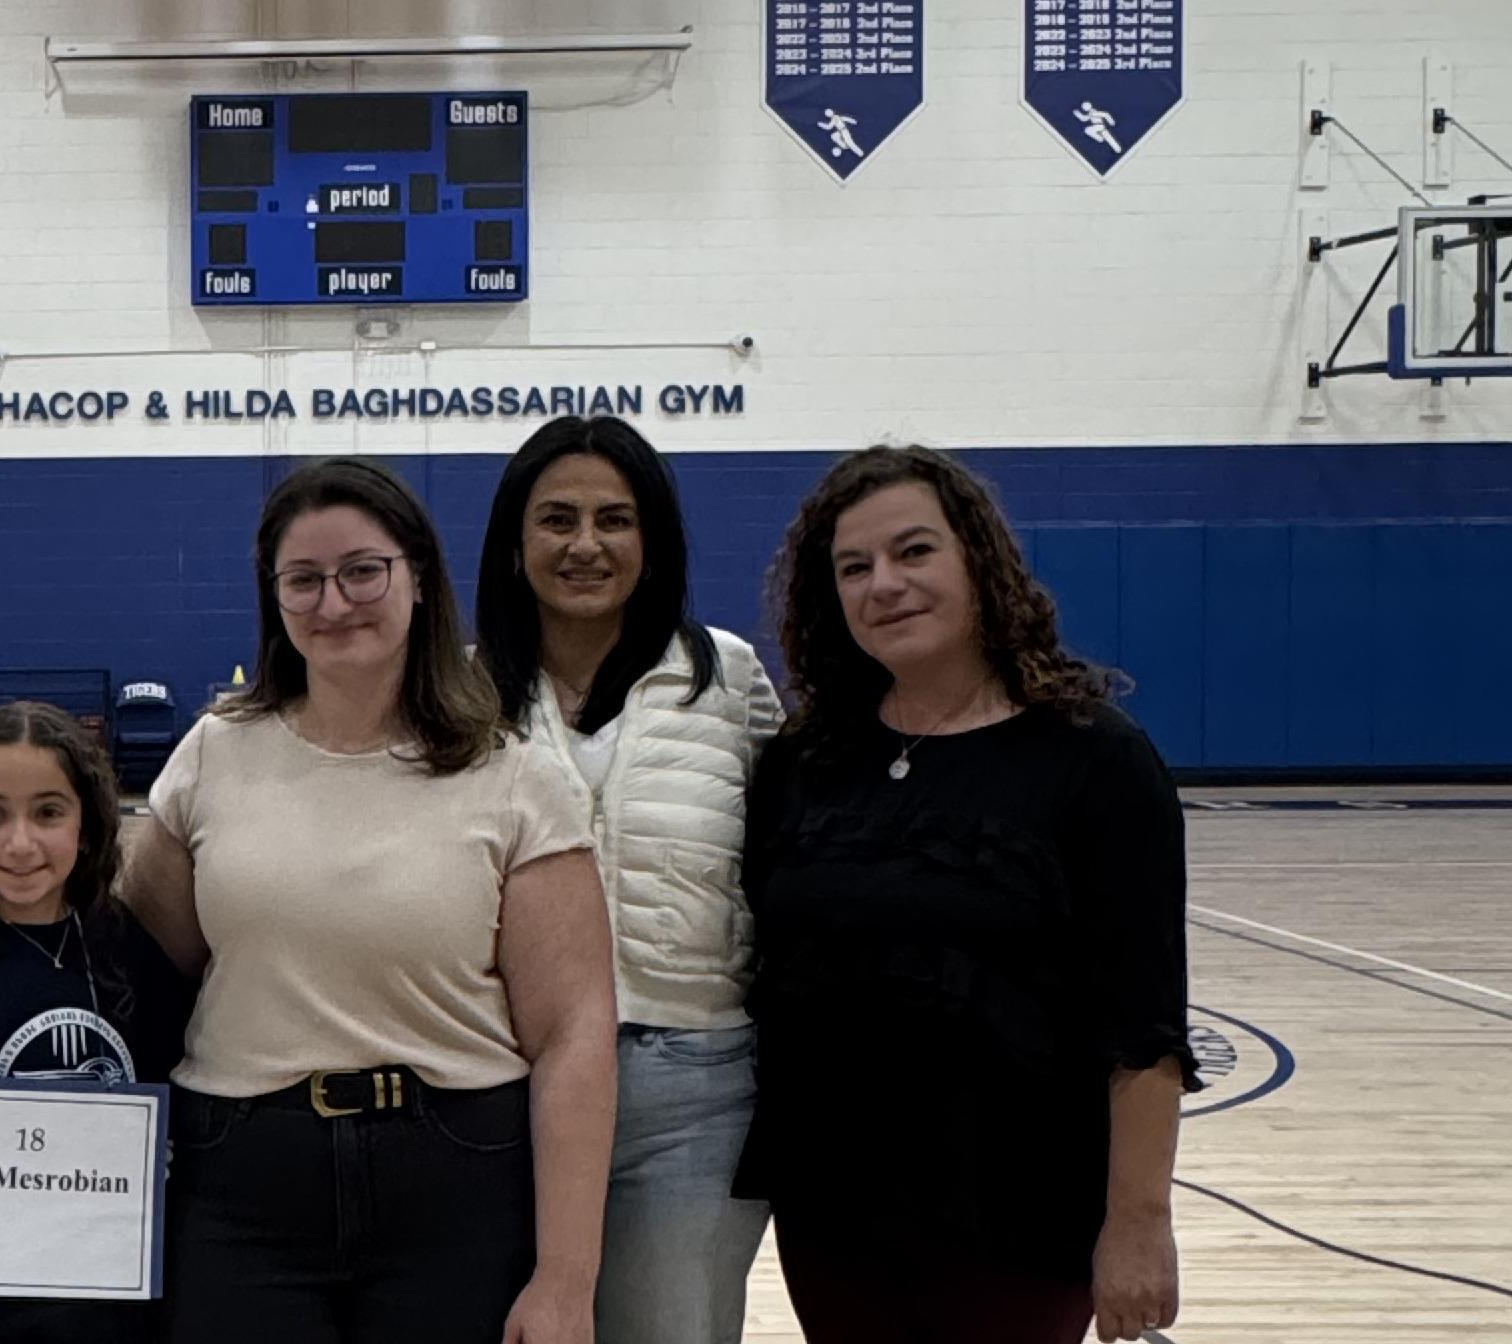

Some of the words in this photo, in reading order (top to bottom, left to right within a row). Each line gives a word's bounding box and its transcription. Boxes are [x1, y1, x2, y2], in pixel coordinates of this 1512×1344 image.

[209, 104, 263, 126] Home
[450, 100, 518, 124] Guests
[330, 185, 390, 212] period
[206, 272, 251, 294] fouls
[328, 269, 391, 295] player
[470, 268, 516, 291] fouls
[145, 393, 169, 419] &
[187, 389, 296, 420] HILDA
[312, 385, 643, 418] BAGHDASSARIAN
[659, 384, 745, 415] GYM
[14, 1128, 46, 1152] 18
